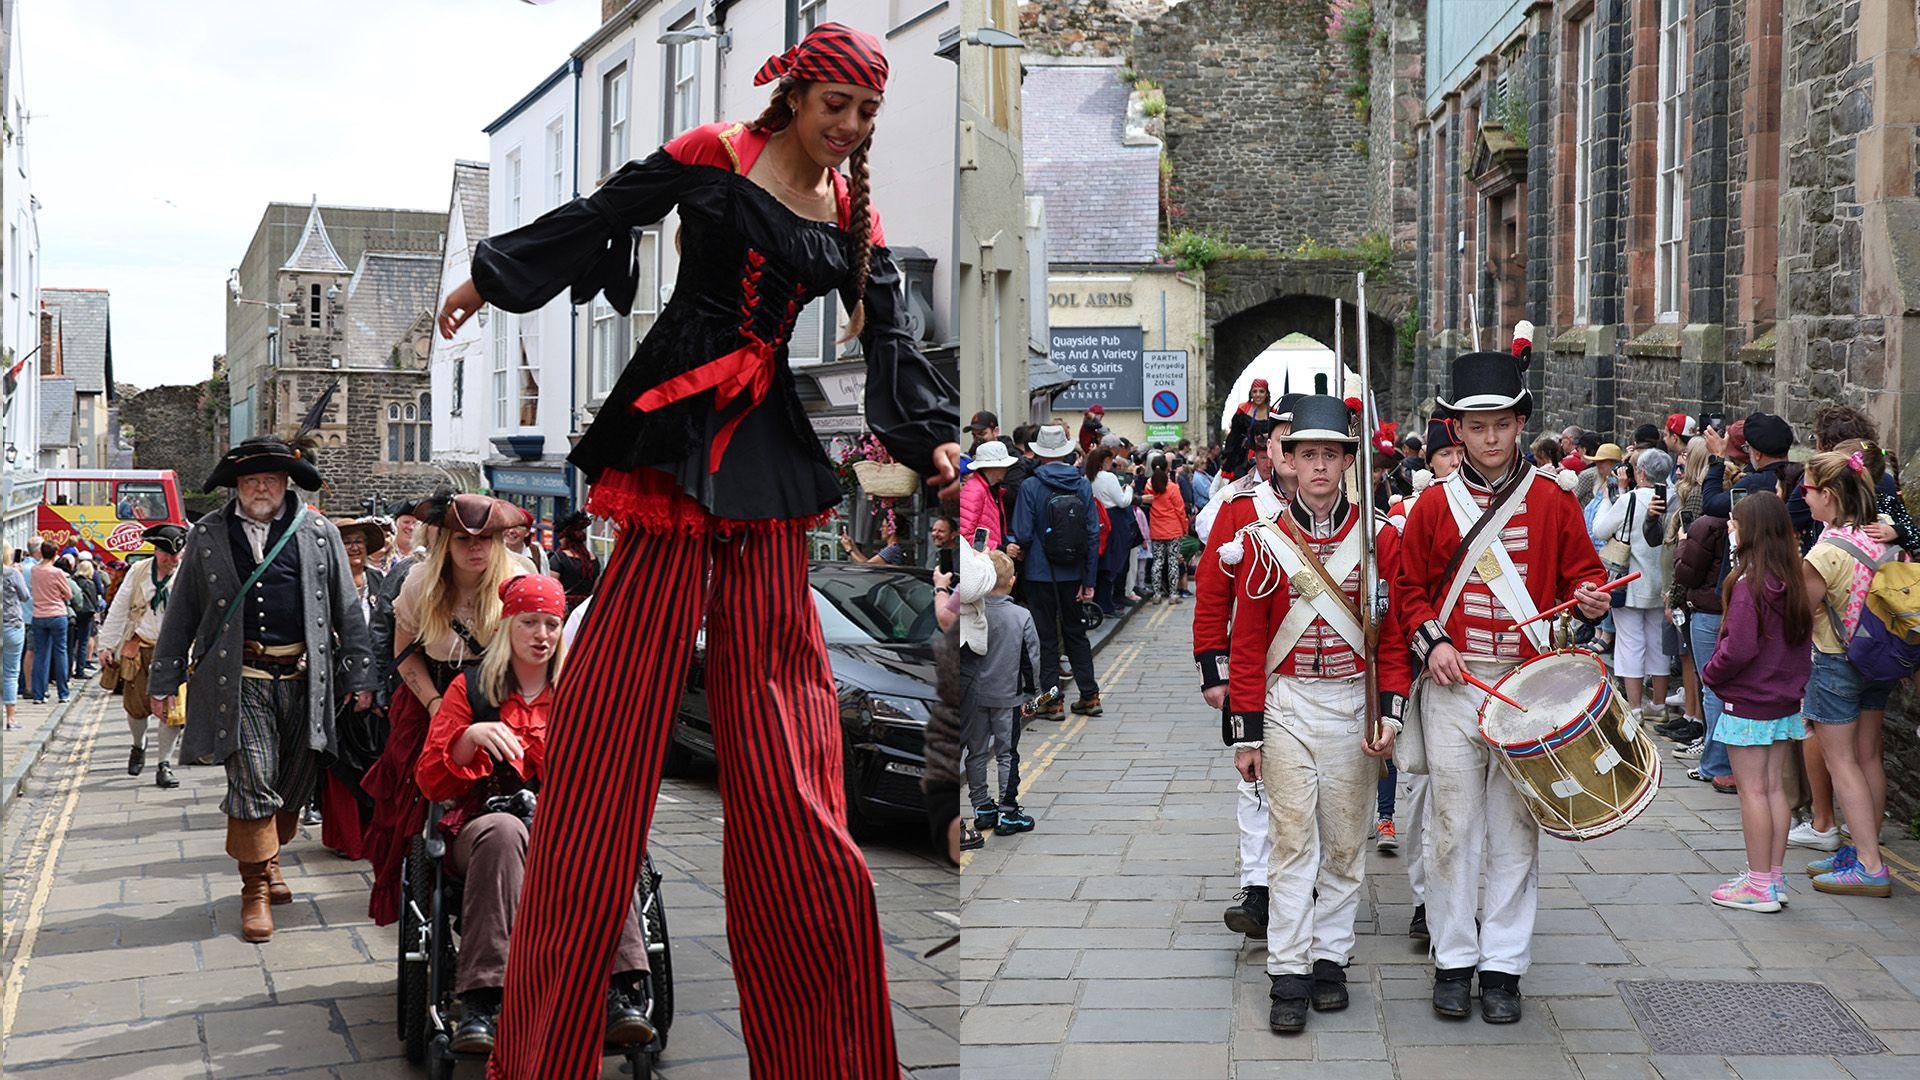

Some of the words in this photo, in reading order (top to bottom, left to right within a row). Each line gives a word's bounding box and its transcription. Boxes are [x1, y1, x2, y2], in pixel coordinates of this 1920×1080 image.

[1048, 292, 1080, 308] OOL
[1085, 292, 1133, 308] ARMS
[1053, 336, 1098, 348] Quayside
[1101, 336, 1120, 346] Pub
[1049, 350, 1066, 360] les
[1069, 350, 1089, 360] And
[1092, 350, 1100, 360] A
[1102, 349, 1138, 361] Variety
[1057, 363, 1077, 373] nes
[1080, 363, 1089, 373] &
[1091, 362, 1123, 375] Spirits
[1144, 362, 1185, 370] Cyfyngedig
[1070, 382, 1114, 390] ELCOME
[1062, 391, 1107, 399] CYNNES
